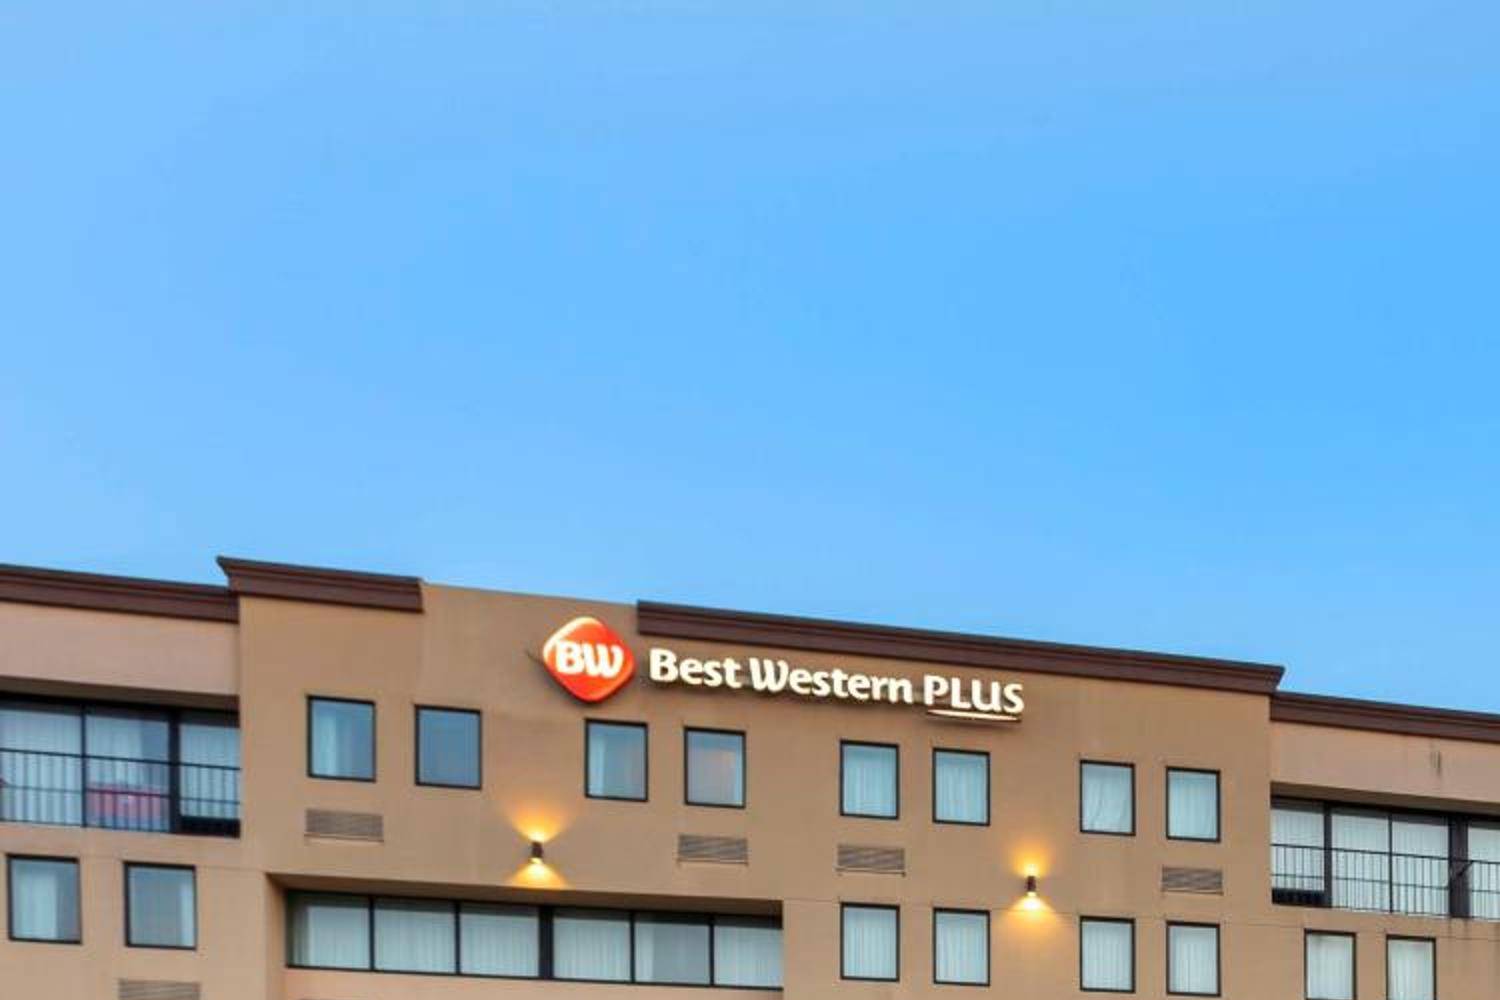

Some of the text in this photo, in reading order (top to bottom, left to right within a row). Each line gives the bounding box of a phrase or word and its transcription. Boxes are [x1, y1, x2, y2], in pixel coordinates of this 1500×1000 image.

[556, 639, 624, 678] BW
[649, 648, 1025, 714] Best Western PLUS
